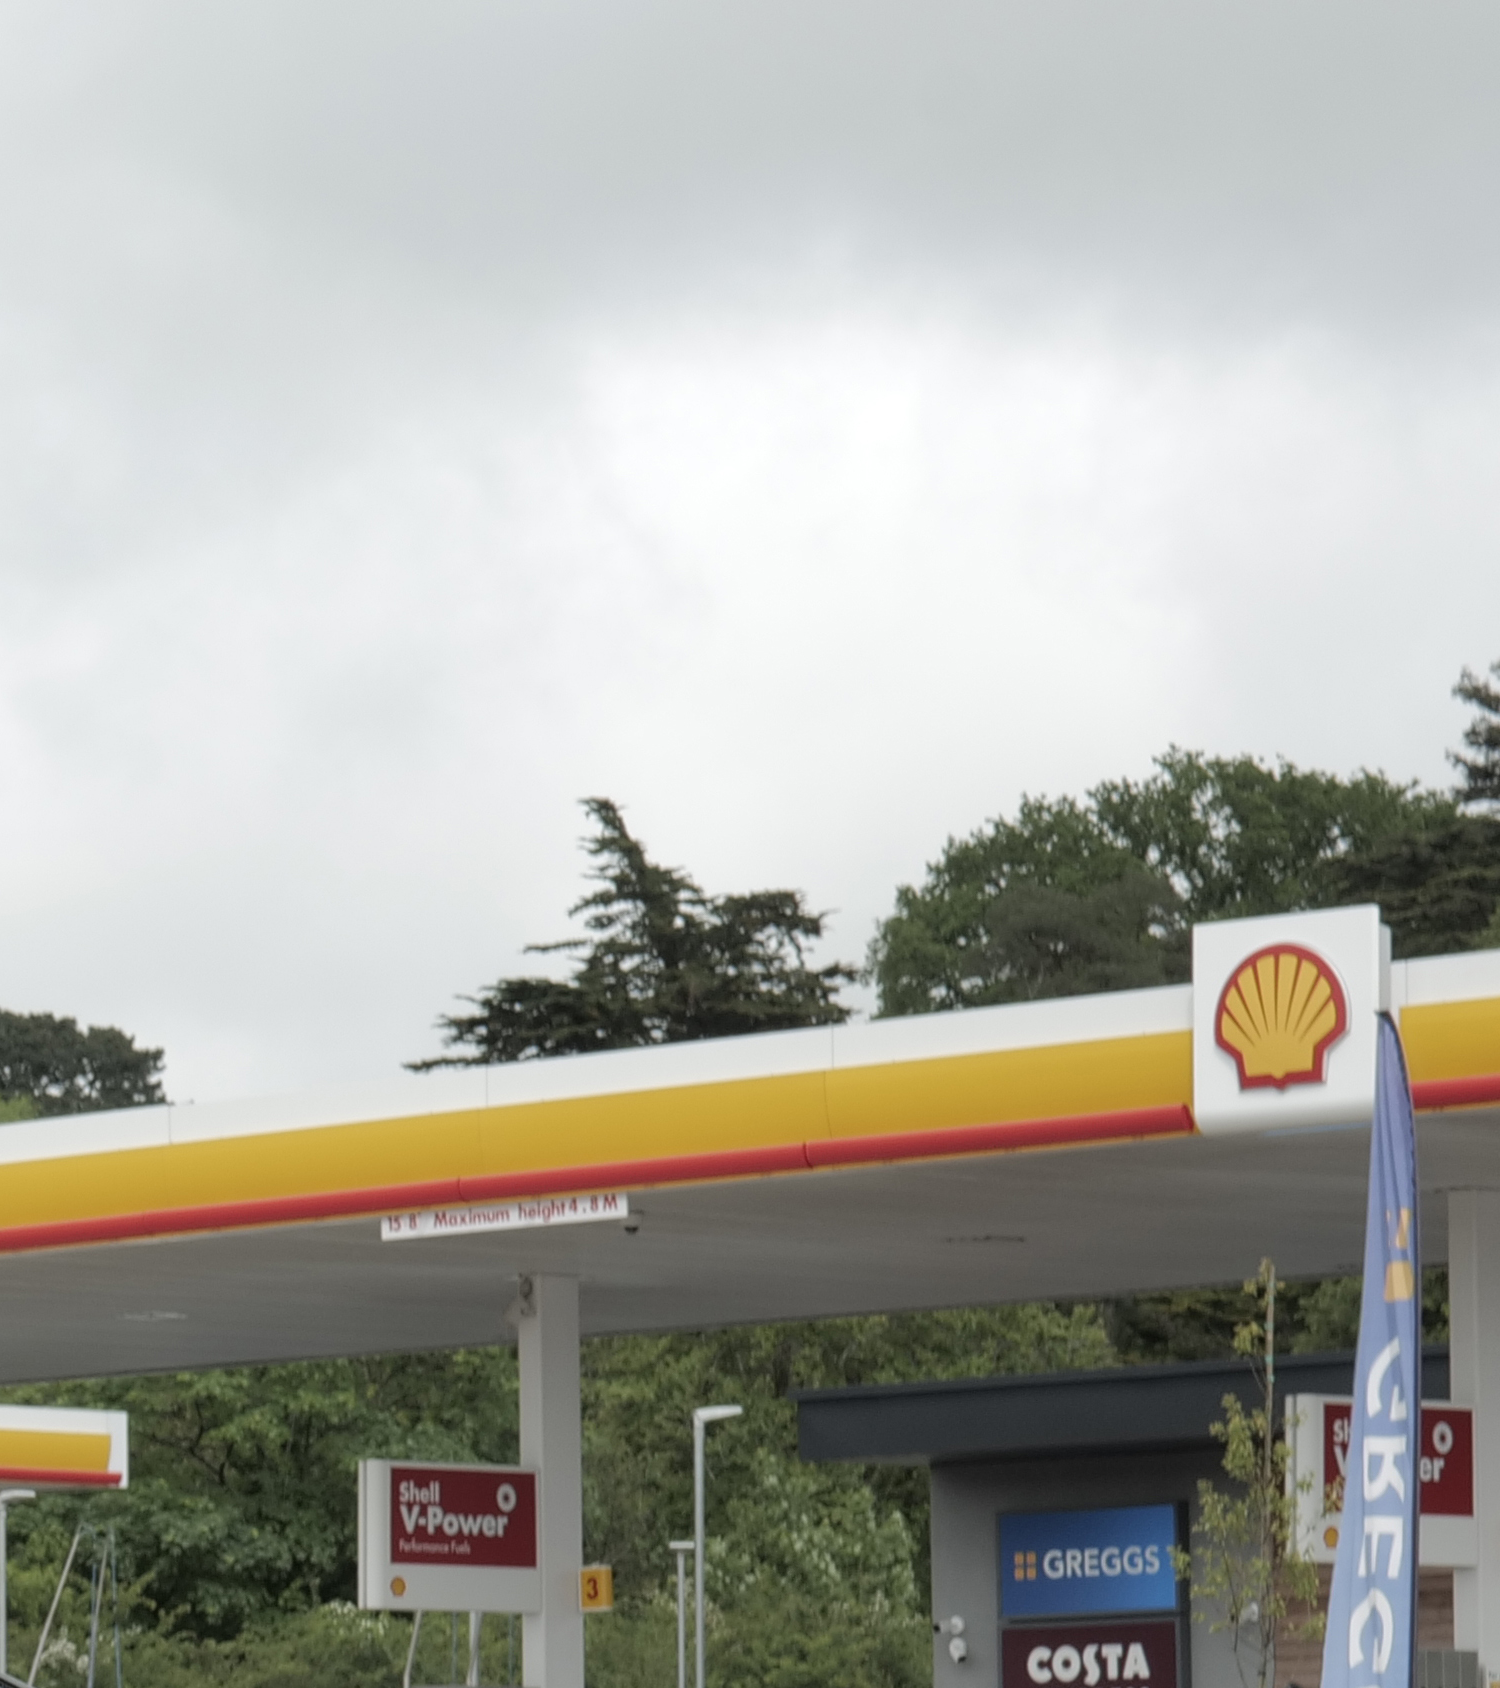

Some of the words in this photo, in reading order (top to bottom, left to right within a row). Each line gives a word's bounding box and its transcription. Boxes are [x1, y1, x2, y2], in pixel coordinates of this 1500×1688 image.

[434, 1207, 510, 1228] Maximum
[518, 1201, 566, 1223] height
[399, 1479, 440, 1505] Shell
[399, 1504, 509, 1538] V-Power
[1043, 1545, 1160, 1580] GREGGS
[587, 1577, 599, 1600] 3
[1027, 1642, 1150, 1687] COSTA
